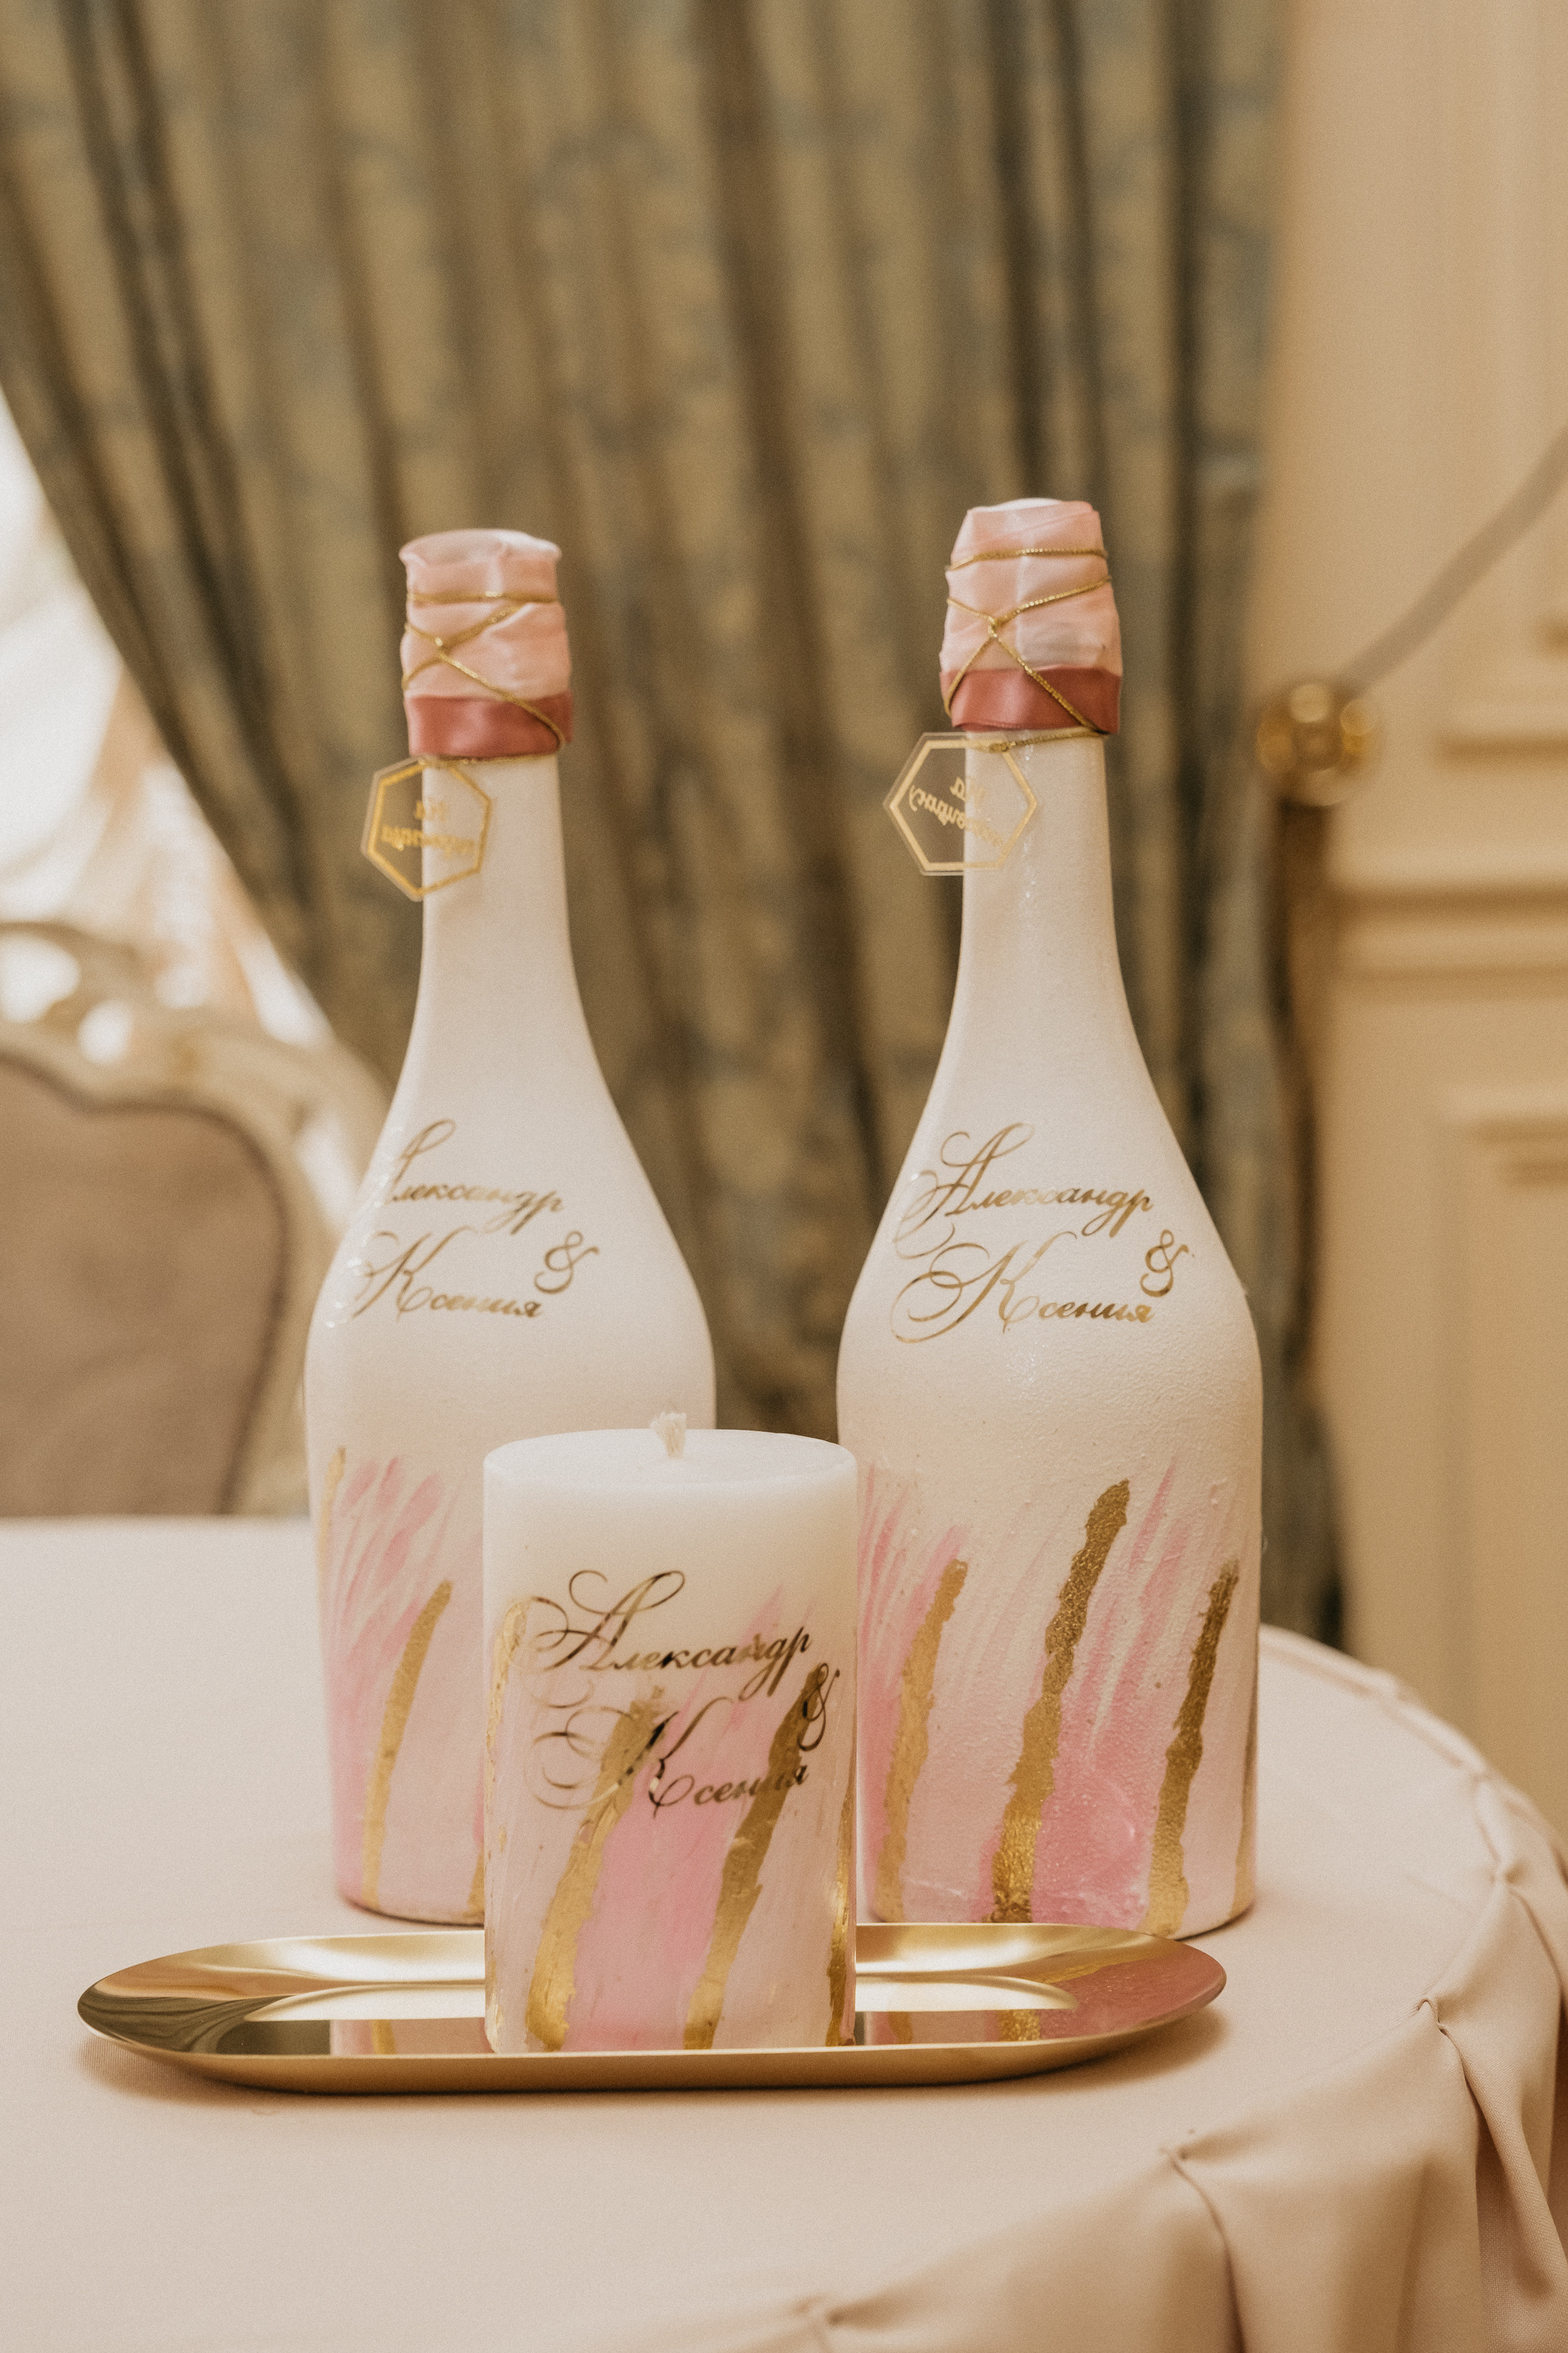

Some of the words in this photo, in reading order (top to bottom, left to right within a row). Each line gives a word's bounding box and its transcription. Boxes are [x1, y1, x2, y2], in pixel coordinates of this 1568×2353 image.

[893, 1122, 1155, 1260] Александр
[352, 1226, 543, 1323] Ксения
[534, 1230, 600, 1295] &
[890, 1231, 1155, 1344] Ксения
[1141, 1229, 1190, 1298] &
[798, 1663, 841, 1752] &
